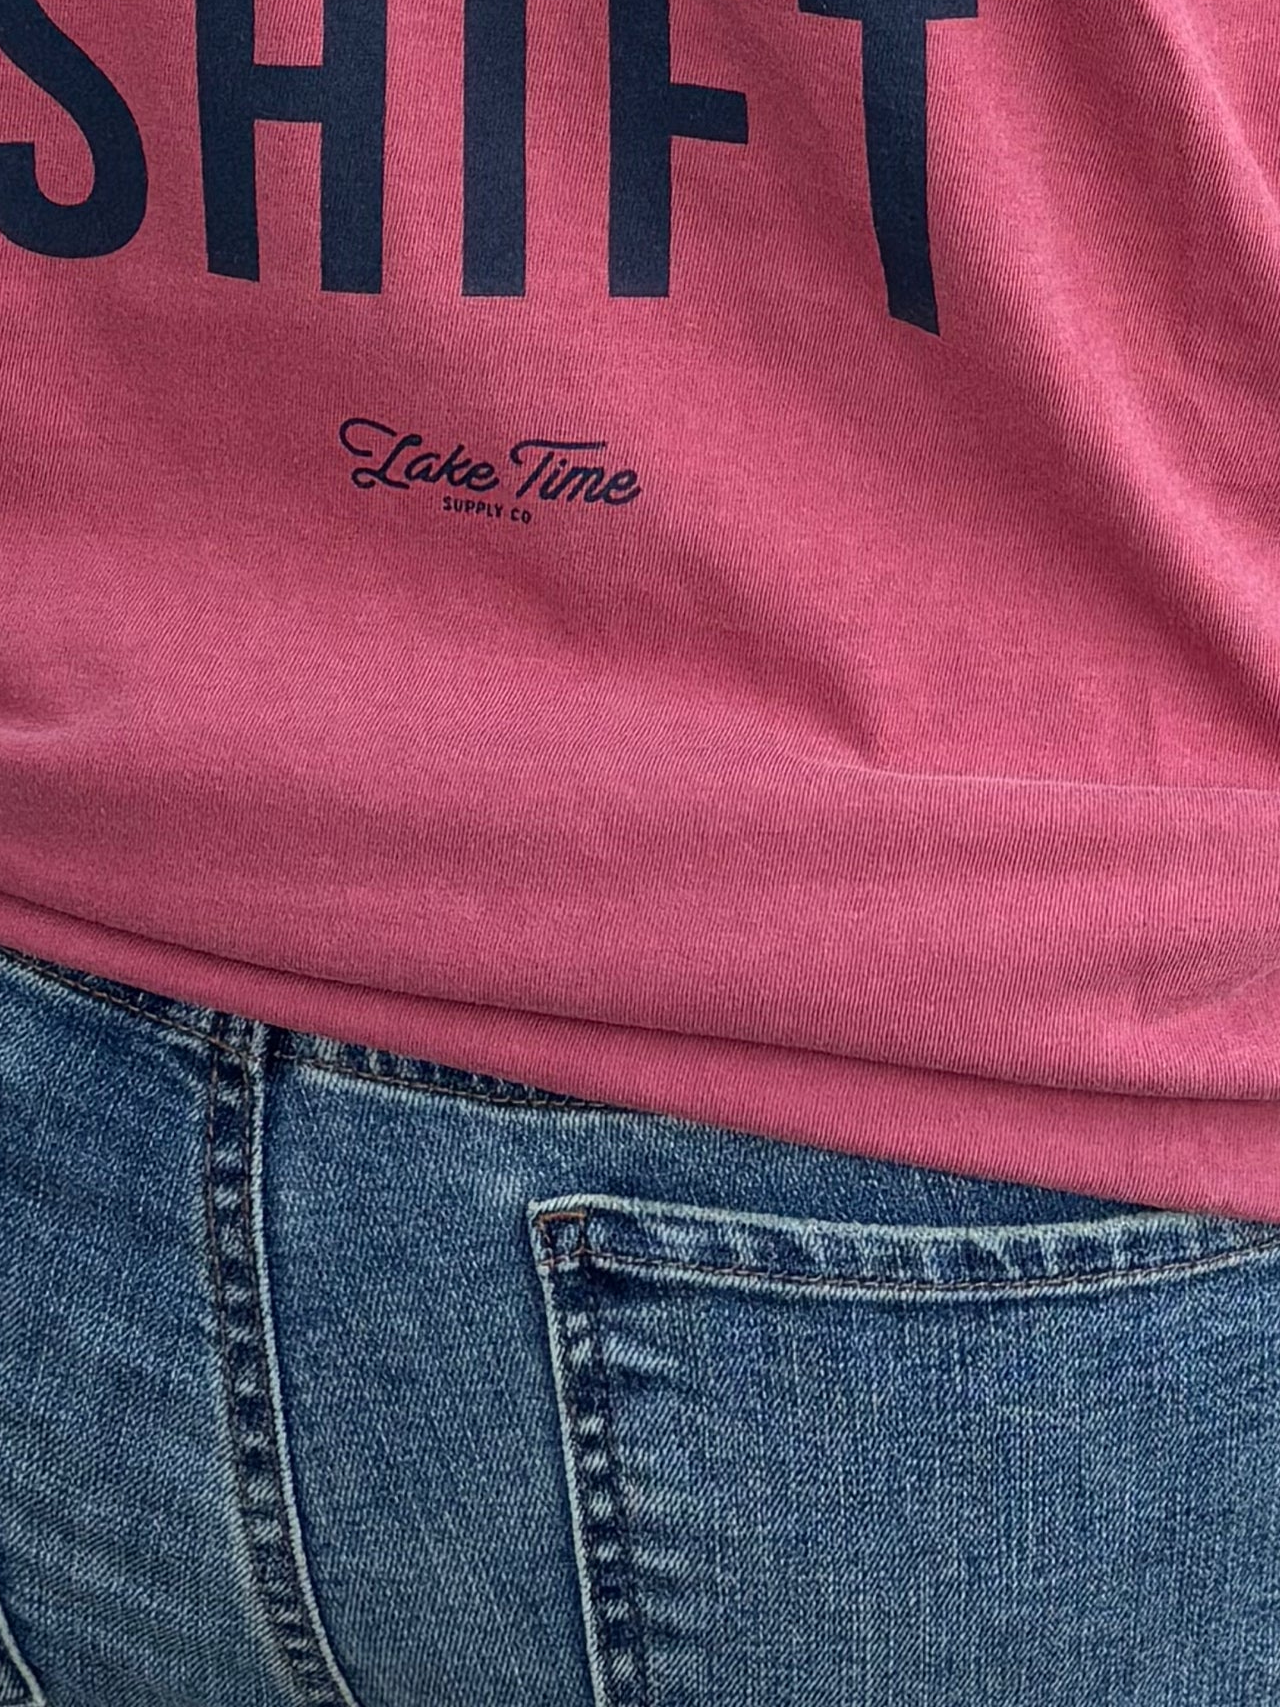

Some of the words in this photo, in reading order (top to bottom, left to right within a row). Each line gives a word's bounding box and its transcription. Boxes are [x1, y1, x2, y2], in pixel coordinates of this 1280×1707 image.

[339, 418, 499, 492] Lake
[510, 439, 640, 505] Time
[442, 495, 503, 518] SUPPLY
[510, 506, 532, 524] CO
